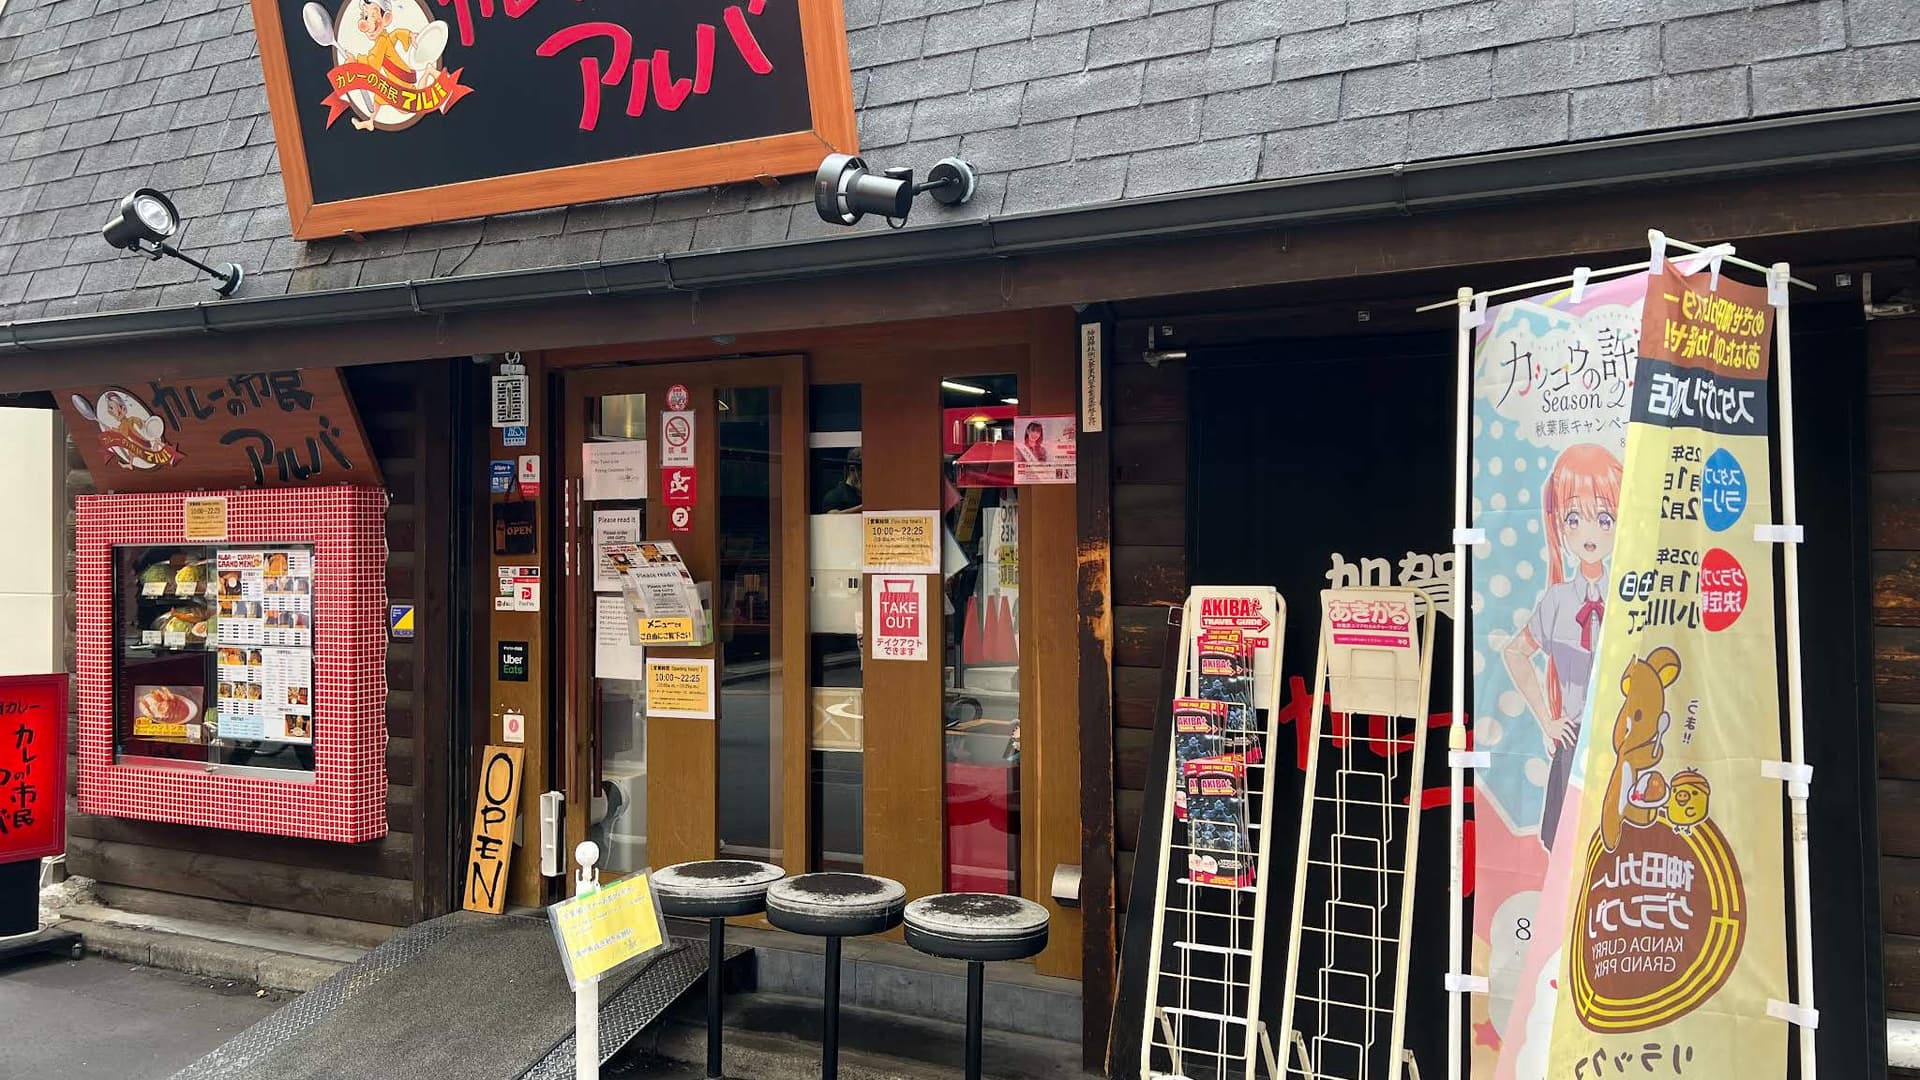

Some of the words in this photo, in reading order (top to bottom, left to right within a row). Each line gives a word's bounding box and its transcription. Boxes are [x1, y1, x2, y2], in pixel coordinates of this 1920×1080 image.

[535, 0, 773, 131] アルバ
[336, 72, 399, 104] カレーの市民
[401, 83, 448, 111] アルバ
[1496, 327, 1640, 408] カッコウの許
[1542, 390, 1601, 413] Season
[1607, 379, 1626, 408] 2
[219, 415, 353, 486] アルバ
[507, 526, 531, 535] OPEN
[881, 602, 917, 614] TAKE
[1201, 599, 1250, 616] AKIBA
[885, 616, 914, 629] OUT
[876, 638, 923, 647] テイクアウト
[503, 654, 523, 664] Uber
[884, 647, 915, 656] できます
[503, 664, 523, 674] Eats
[1203, 660, 1228, 668] AKIBA
[10, 723, 38, 829] カレーの市民
[1202, 780, 1226, 788] AKIBA
[470, 752, 514, 908] OPEN
[1516, 917, 1532, 941] 8
